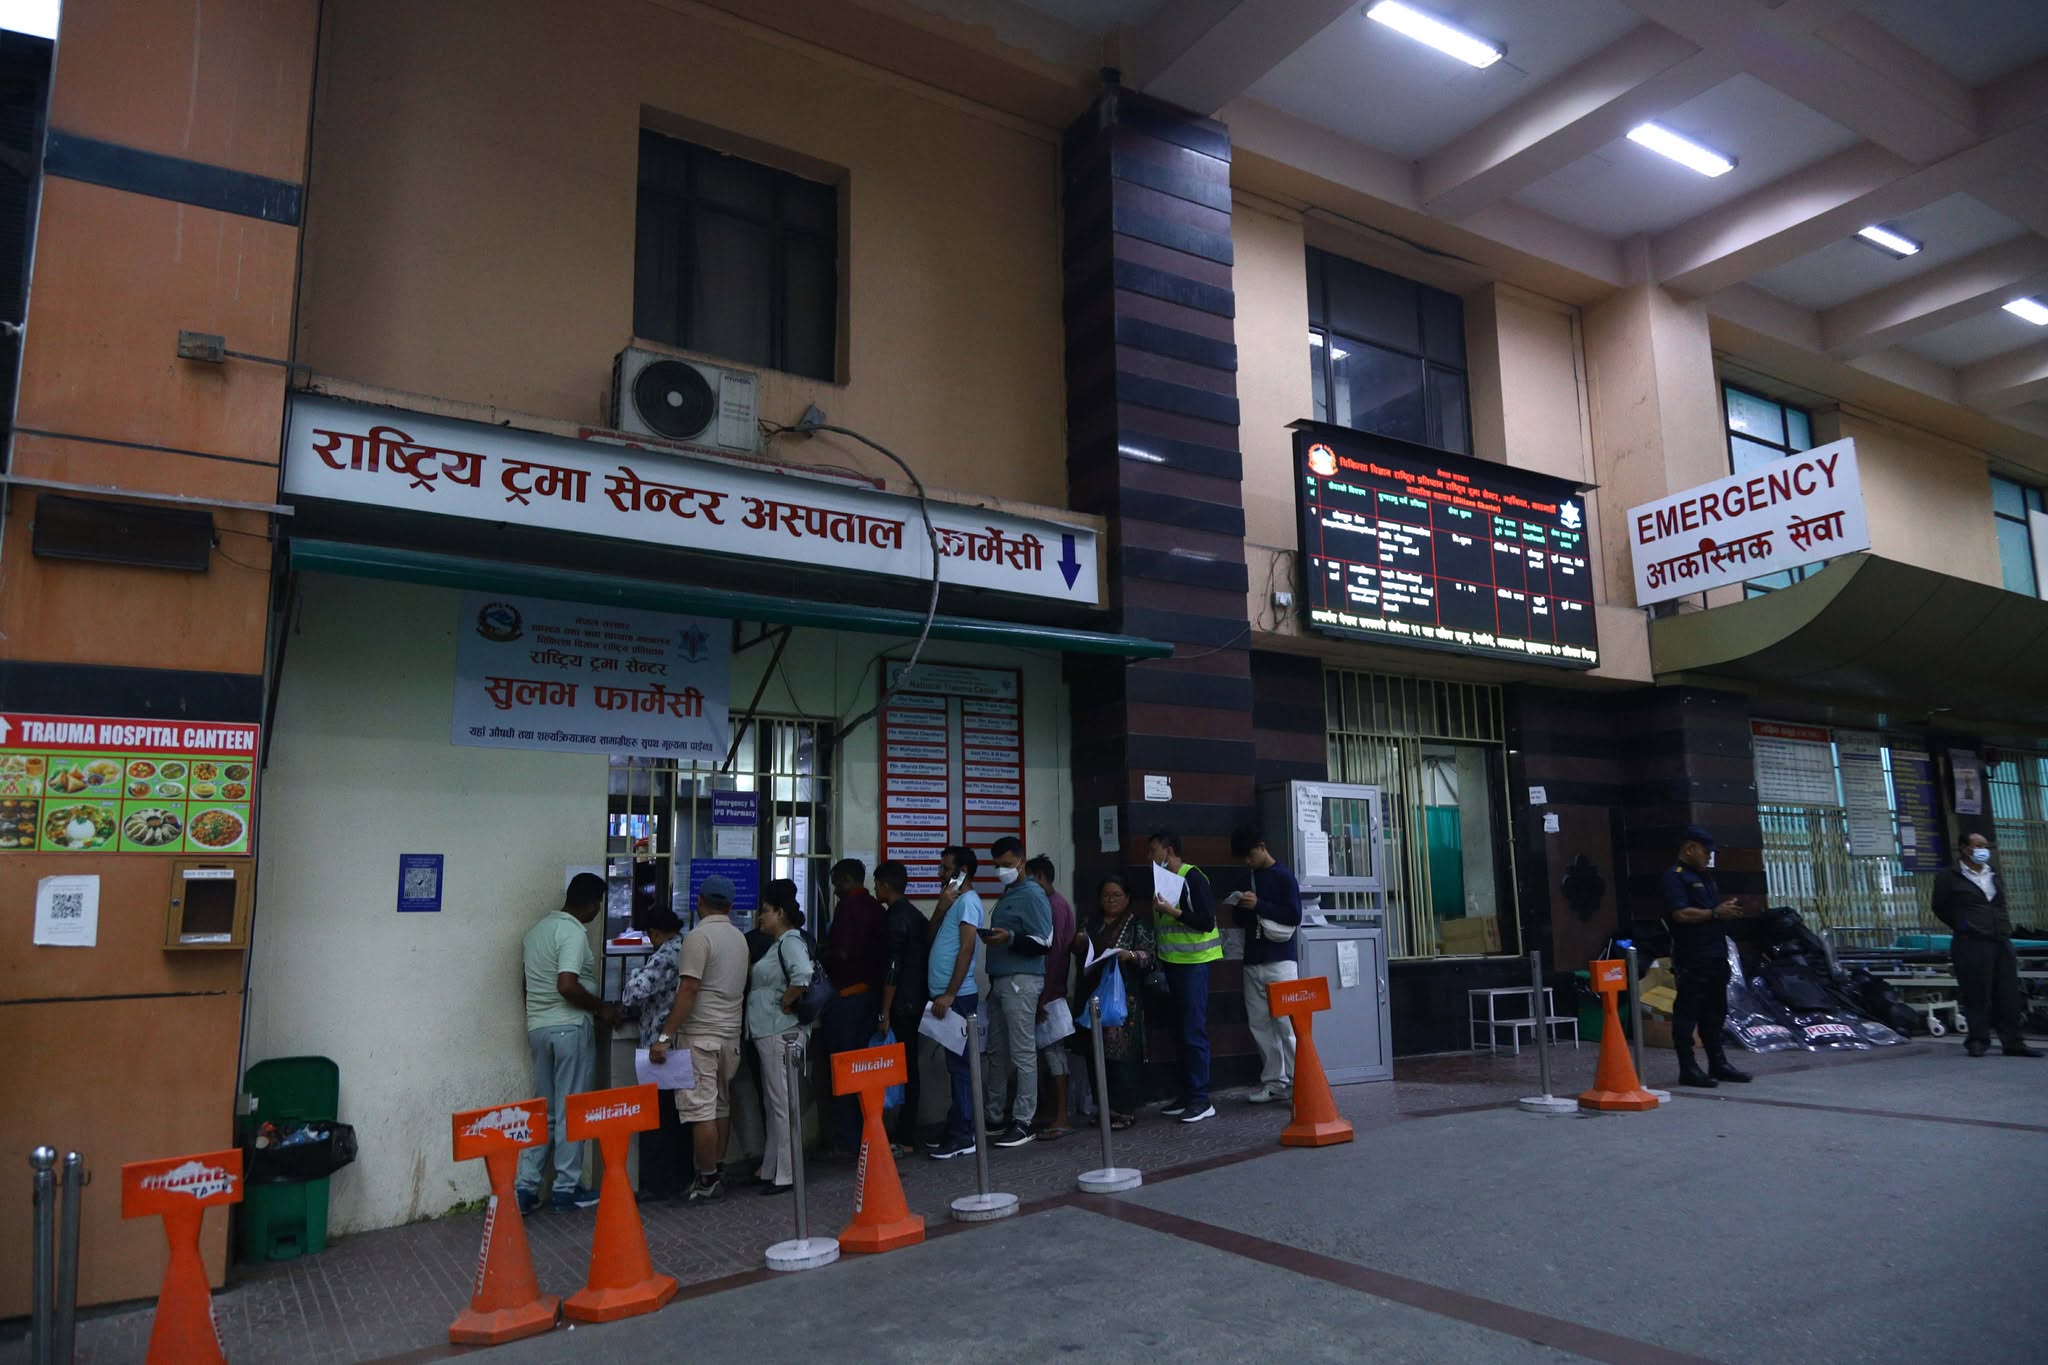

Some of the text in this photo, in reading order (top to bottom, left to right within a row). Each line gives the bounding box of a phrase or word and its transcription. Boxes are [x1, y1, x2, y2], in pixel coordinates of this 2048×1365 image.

[312, 426, 487, 493] राष्ट्रिय
[501, 458, 591, 506] ट्रमा
[604, 466, 729, 527] सेन्टर
[741, 495, 905, 550] अस्पताल
[1637, 453, 1839, 545] EMERGENCY
[1646, 530, 1774, 590] आकस्मिक
[1786, 510, 1846, 552] सेवा
[530, 649, 668, 677] राष्ट्रिय ट्रमा सेन्टर
[484, 676, 704, 718] सुलभ फार्मेसी
[21, 721, 254, 750] TRAUMA HOSPITAL CANTEEN
[518, 729, 534, 741] तथा
[714, 808, 756, 818] IPD Pharmacy
[715, 799, 747, 808] Emergency
